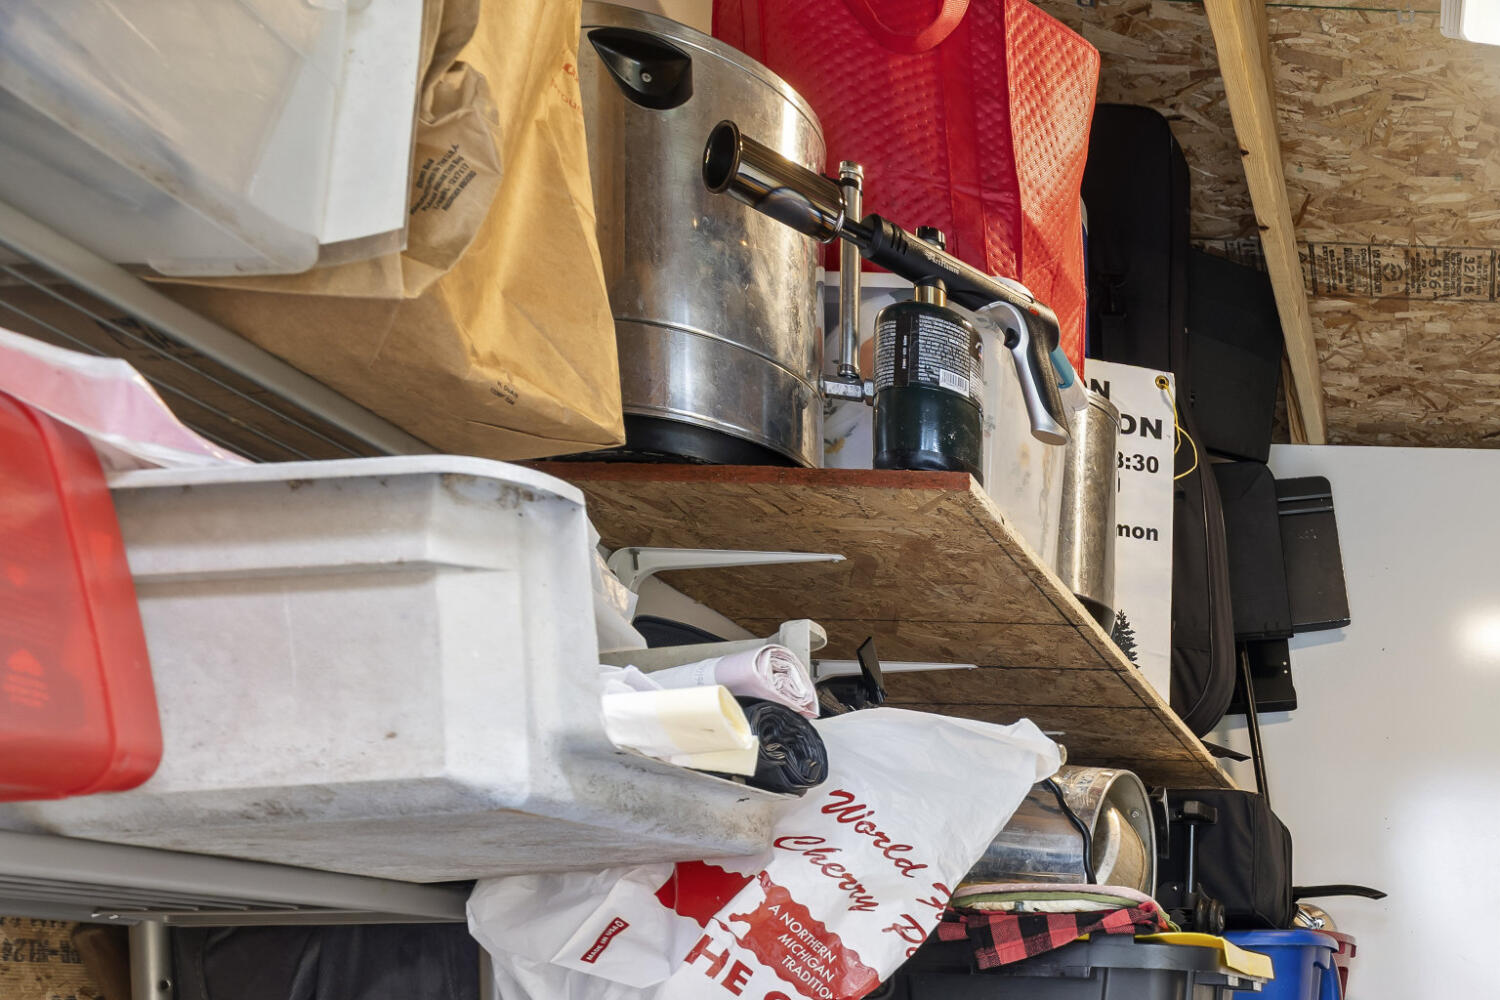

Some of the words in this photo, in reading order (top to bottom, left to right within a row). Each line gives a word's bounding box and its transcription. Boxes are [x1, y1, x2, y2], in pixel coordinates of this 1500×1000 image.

[1373, 259, 1383, 294] CATEGORY
[1464, 256, 1475, 294] 32/16
[821, 789, 928, 879] World
[773, 835, 879, 912] Cherry
[586, 944, 603, 961] MADE
[605, 924, 619, 936] USA
[768, 904, 781, 916] A
[780, 912, 837, 964] NORTHERN
[777, 933, 835, 983] MICHIGAN
